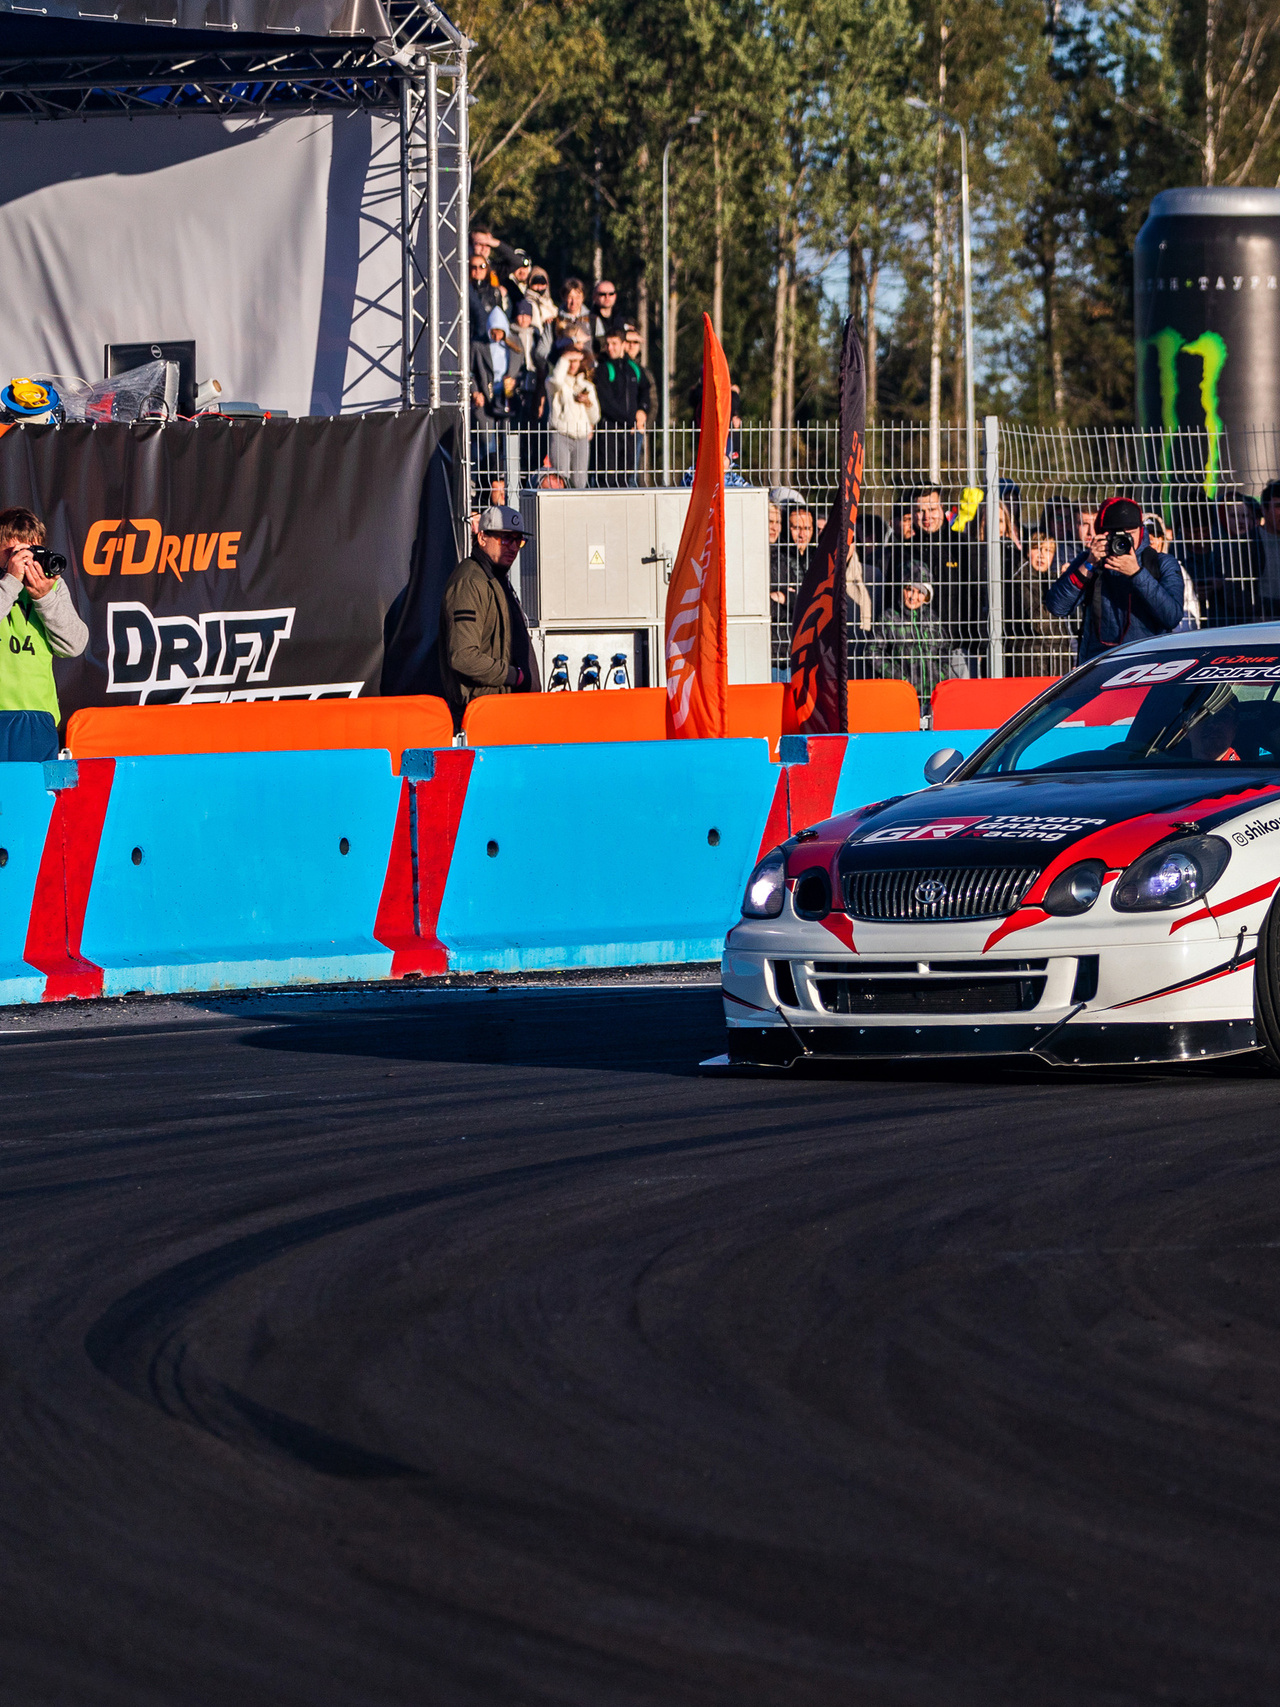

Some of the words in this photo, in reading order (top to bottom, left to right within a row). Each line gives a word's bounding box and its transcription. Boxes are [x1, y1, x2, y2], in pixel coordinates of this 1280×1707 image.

[106, 601, 296, 693] DRIFT
[1101, 659, 1198, 689] 09
[974, 822, 1083, 832] GAZOO
[994, 815, 1106, 825] TOYOTA
[862, 824, 966, 843] GR
[960, 829, 1067, 841] Racing
